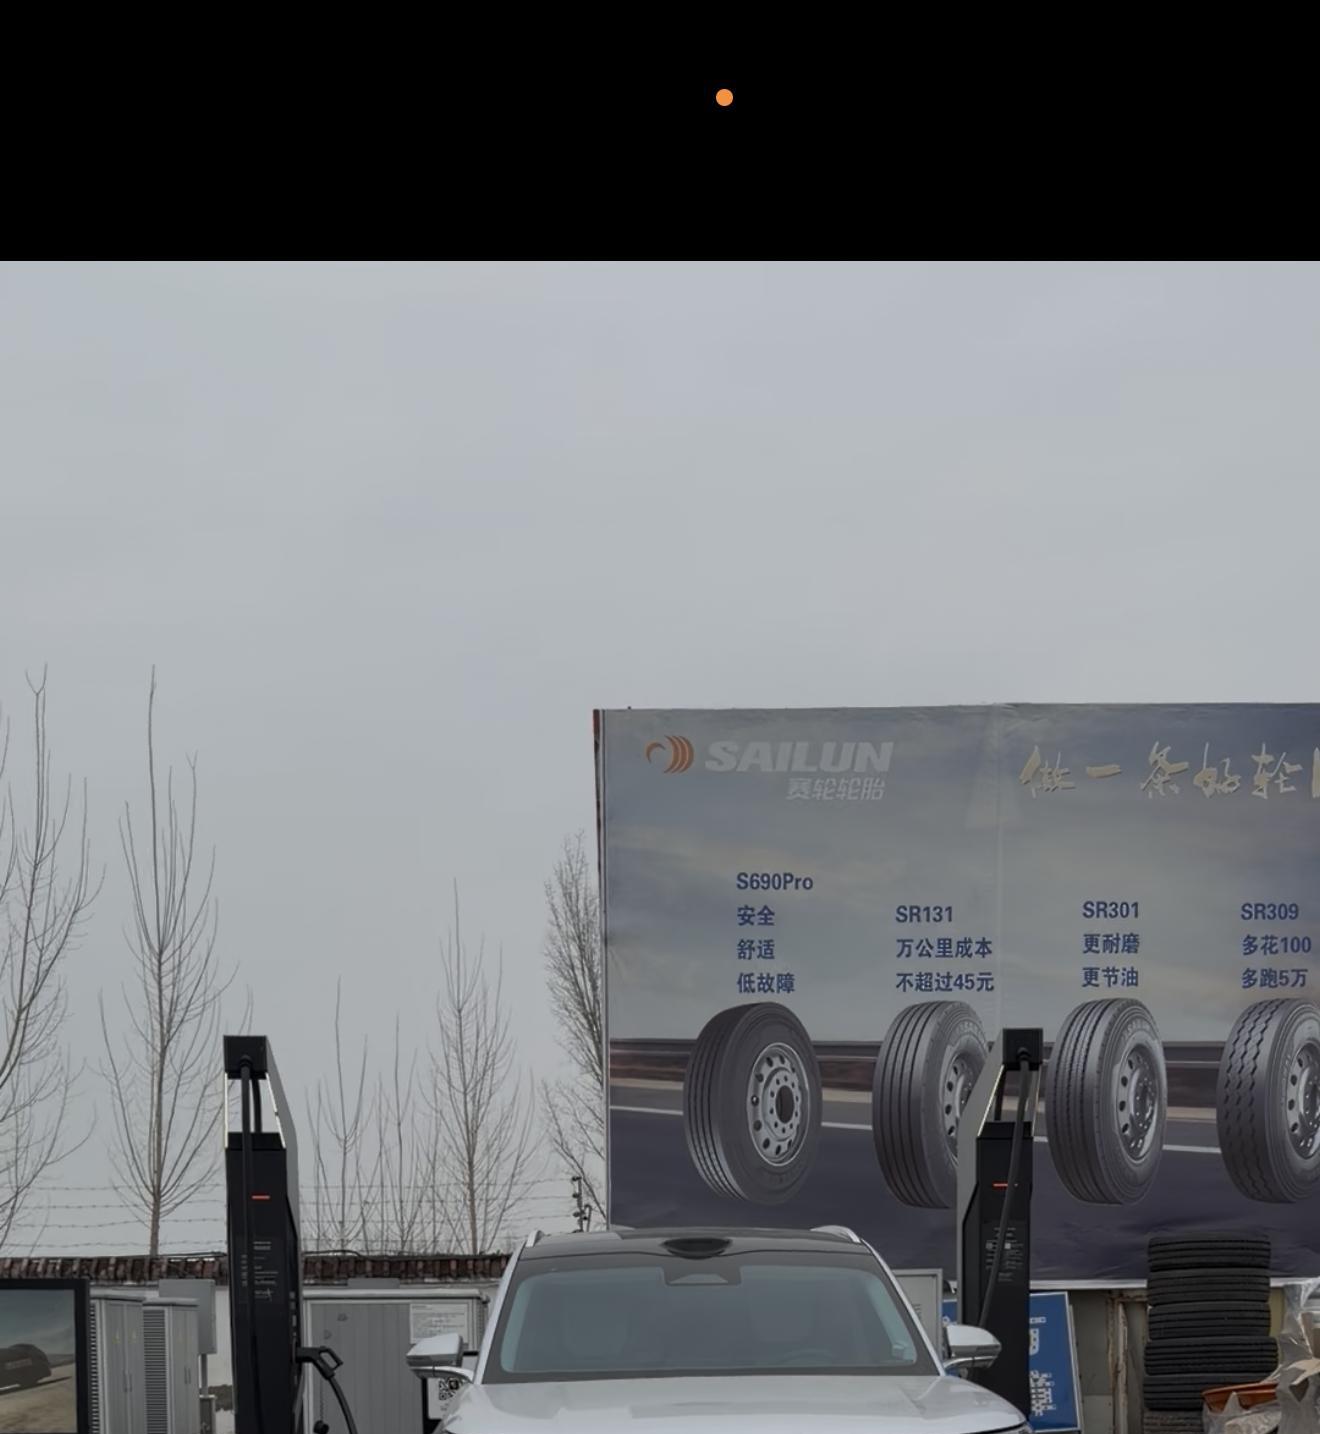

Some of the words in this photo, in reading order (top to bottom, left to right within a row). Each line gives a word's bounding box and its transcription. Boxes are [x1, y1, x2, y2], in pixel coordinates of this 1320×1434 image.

[705, 741, 894, 772] SAILUN
[1019, 741, 1320, 800] 做一条好轮
[787, 777, 886, 801] 赛轮轮胎
[736, 872, 814, 890] S690Pro
[736, 905, 776, 927] 安全
[895, 905, 953, 923] SR131
[1082, 901, 1139, 919] SR301
[1240, 903, 1299, 921] SR309
[736, 938, 776, 960] 舒适
[896, 937, 993, 959] 万公里成本
[1082, 933, 1140, 955] 更耐磨
[1242, 935, 1312, 957] 多花100
[736, 971, 796, 994] 低故障
[895, 971, 995, 993] 不超过45元
[1081, 966, 1139, 988] 更节油
[1241, 968, 1309, 990] 多跑5万
